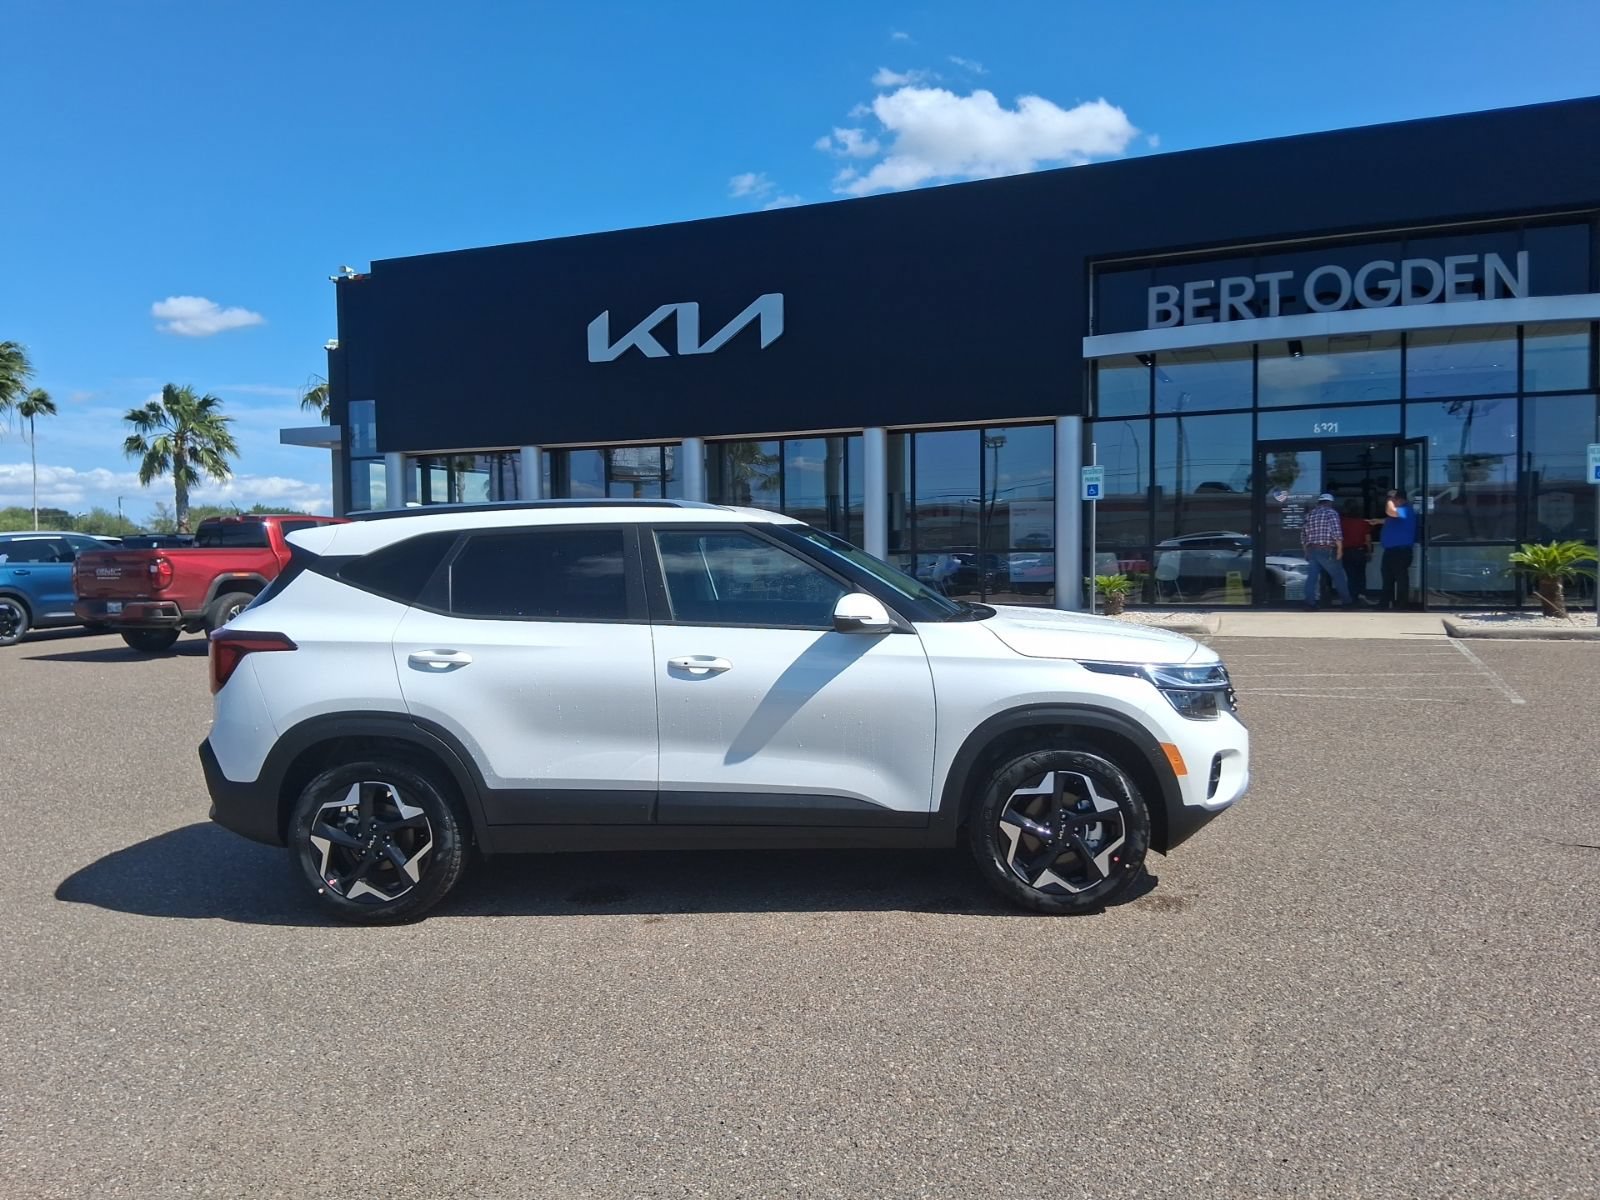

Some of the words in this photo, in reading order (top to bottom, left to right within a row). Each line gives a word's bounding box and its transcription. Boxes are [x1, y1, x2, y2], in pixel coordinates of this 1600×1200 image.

[587, 292, 784, 363] KIA
[1147, 270, 1294, 330] BERT
[1303, 250, 1529, 313] OGDEN
